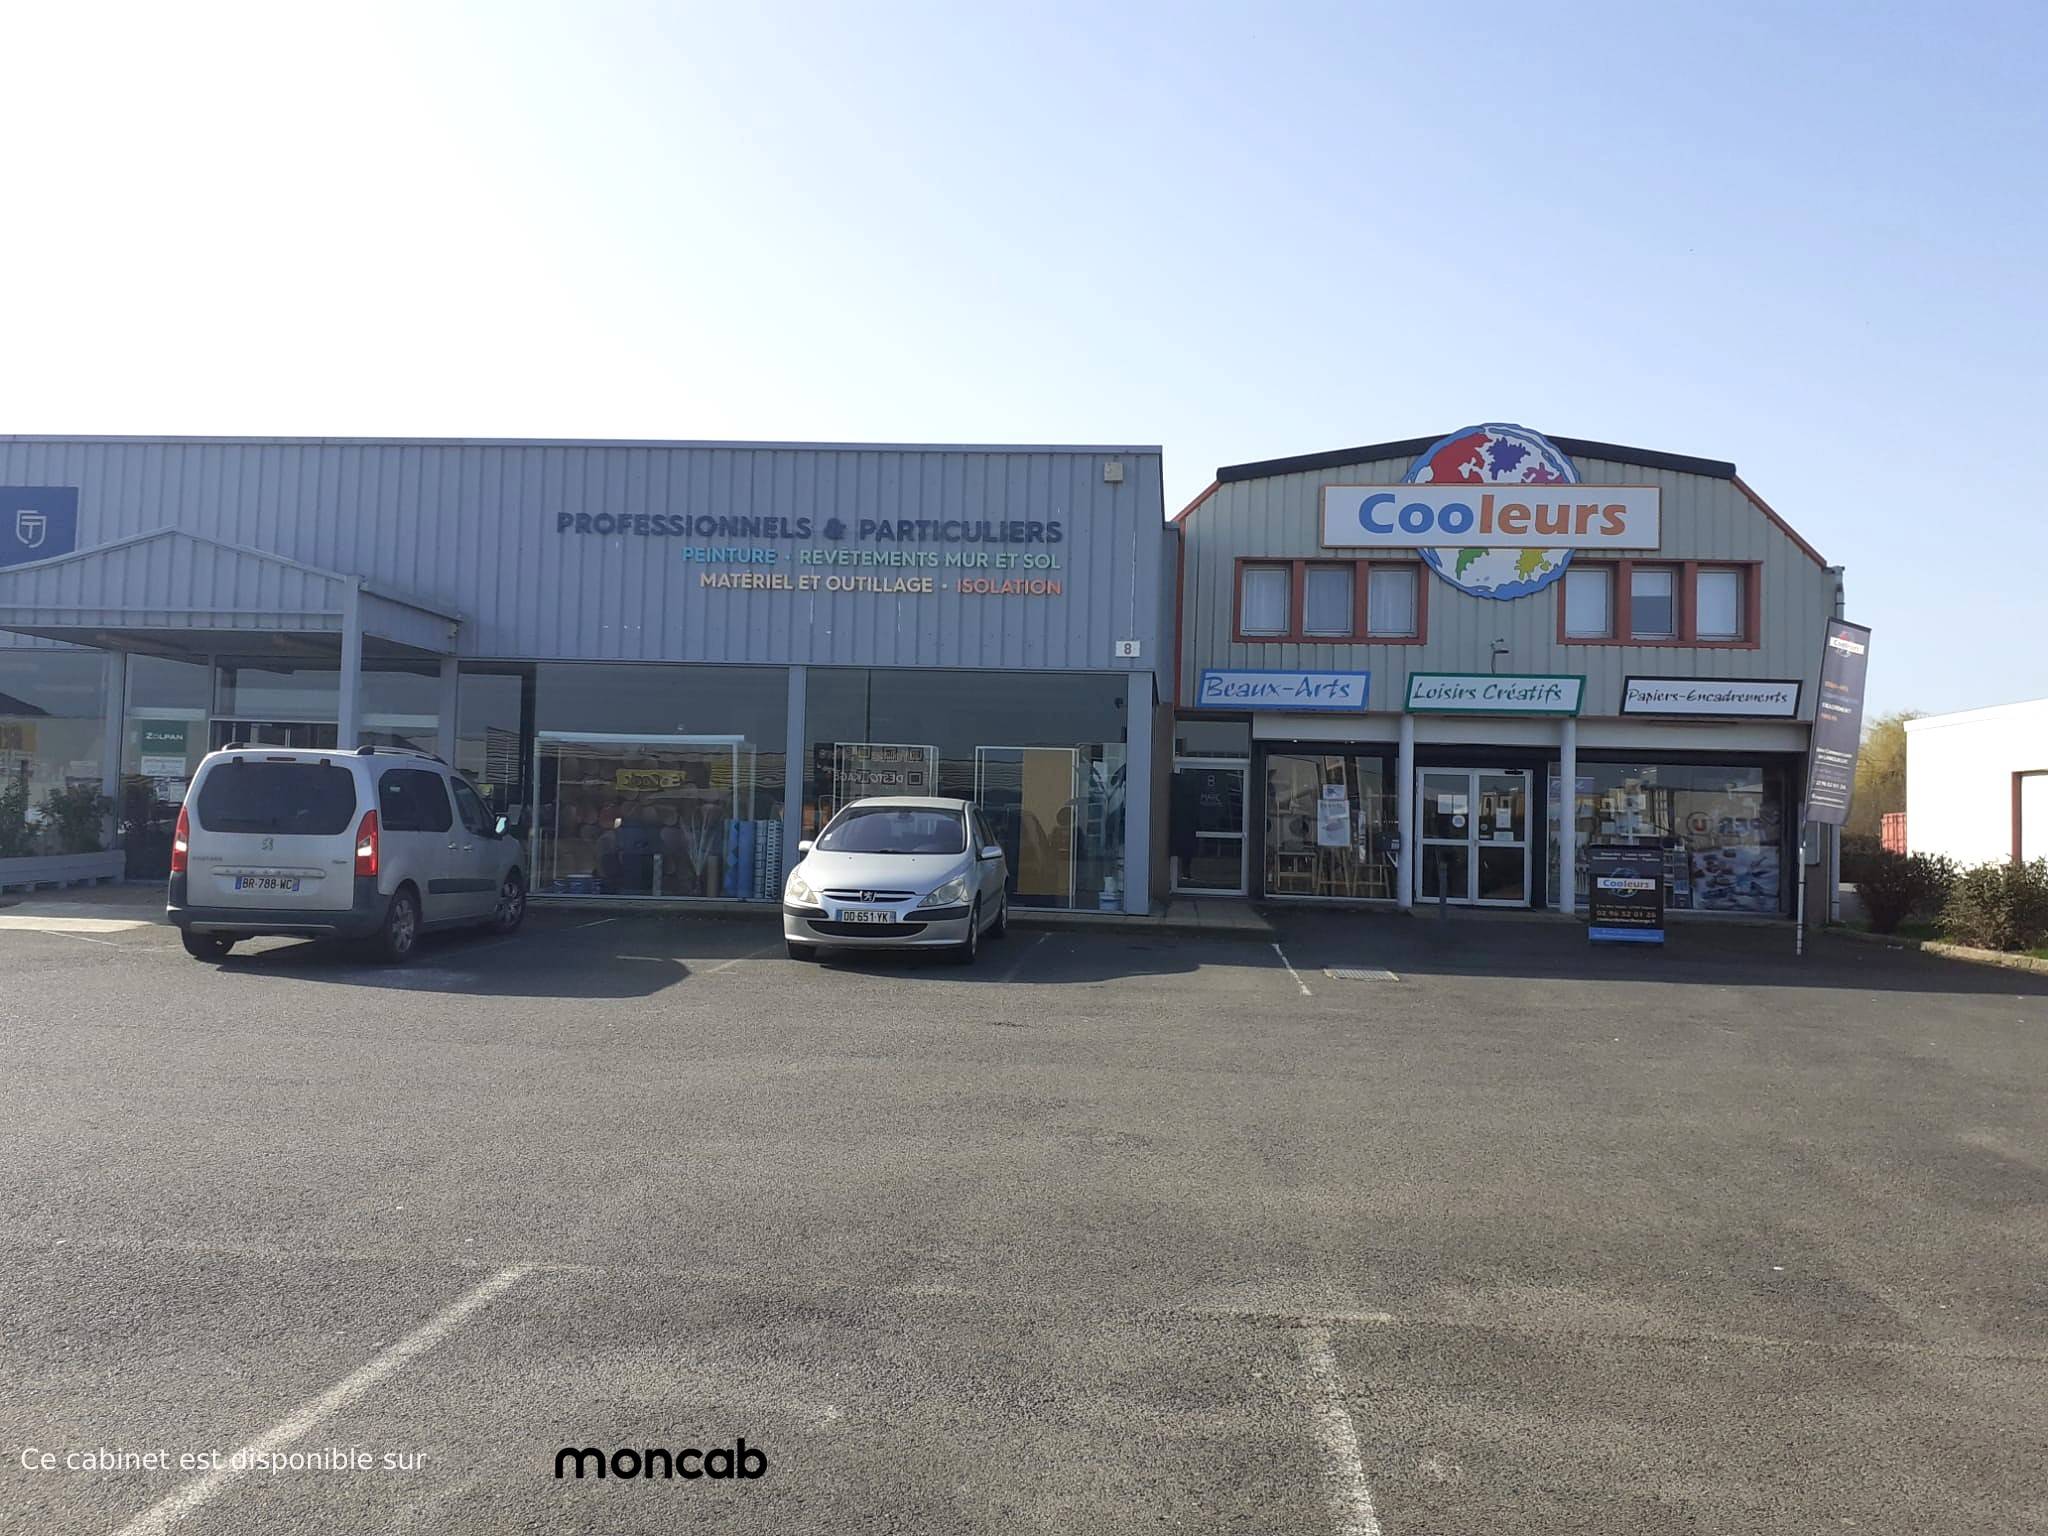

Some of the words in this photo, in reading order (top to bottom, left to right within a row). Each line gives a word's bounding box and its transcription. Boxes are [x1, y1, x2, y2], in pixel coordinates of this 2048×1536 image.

[1358, 493, 1627, 535] Cooleurs
[556, 512, 812, 539] PROFESSIONNELS
[823, 518, 847, 541] &
[859, 519, 1063, 543] PARTICULIERS
[682, 547, 777, 564] PEINTURE
[800, 547, 938, 568] REVÊTEMENTS
[945, 552, 988, 568] MUR
[996, 553, 1018, 569] ET
[1023, 554, 1061, 570] SOL
[700, 570, 793, 590] MATÉRIEL
[799, 575, 821, 590] ET
[826, 576, 933, 593] OUTILLAGE
[956, 578, 1061, 595] ISOLATION
[1124, 643, 1132, 655] 8
[1204, 676, 1351, 699] Beaux-Arts
[1413, 682, 1477, 700] Loisirs
[1483, 683, 1563, 702] Créatifs
[1628, 688, 1788, 703] Papiers-Encadrements
[1602, 878, 1650, 889] Cooleurs
